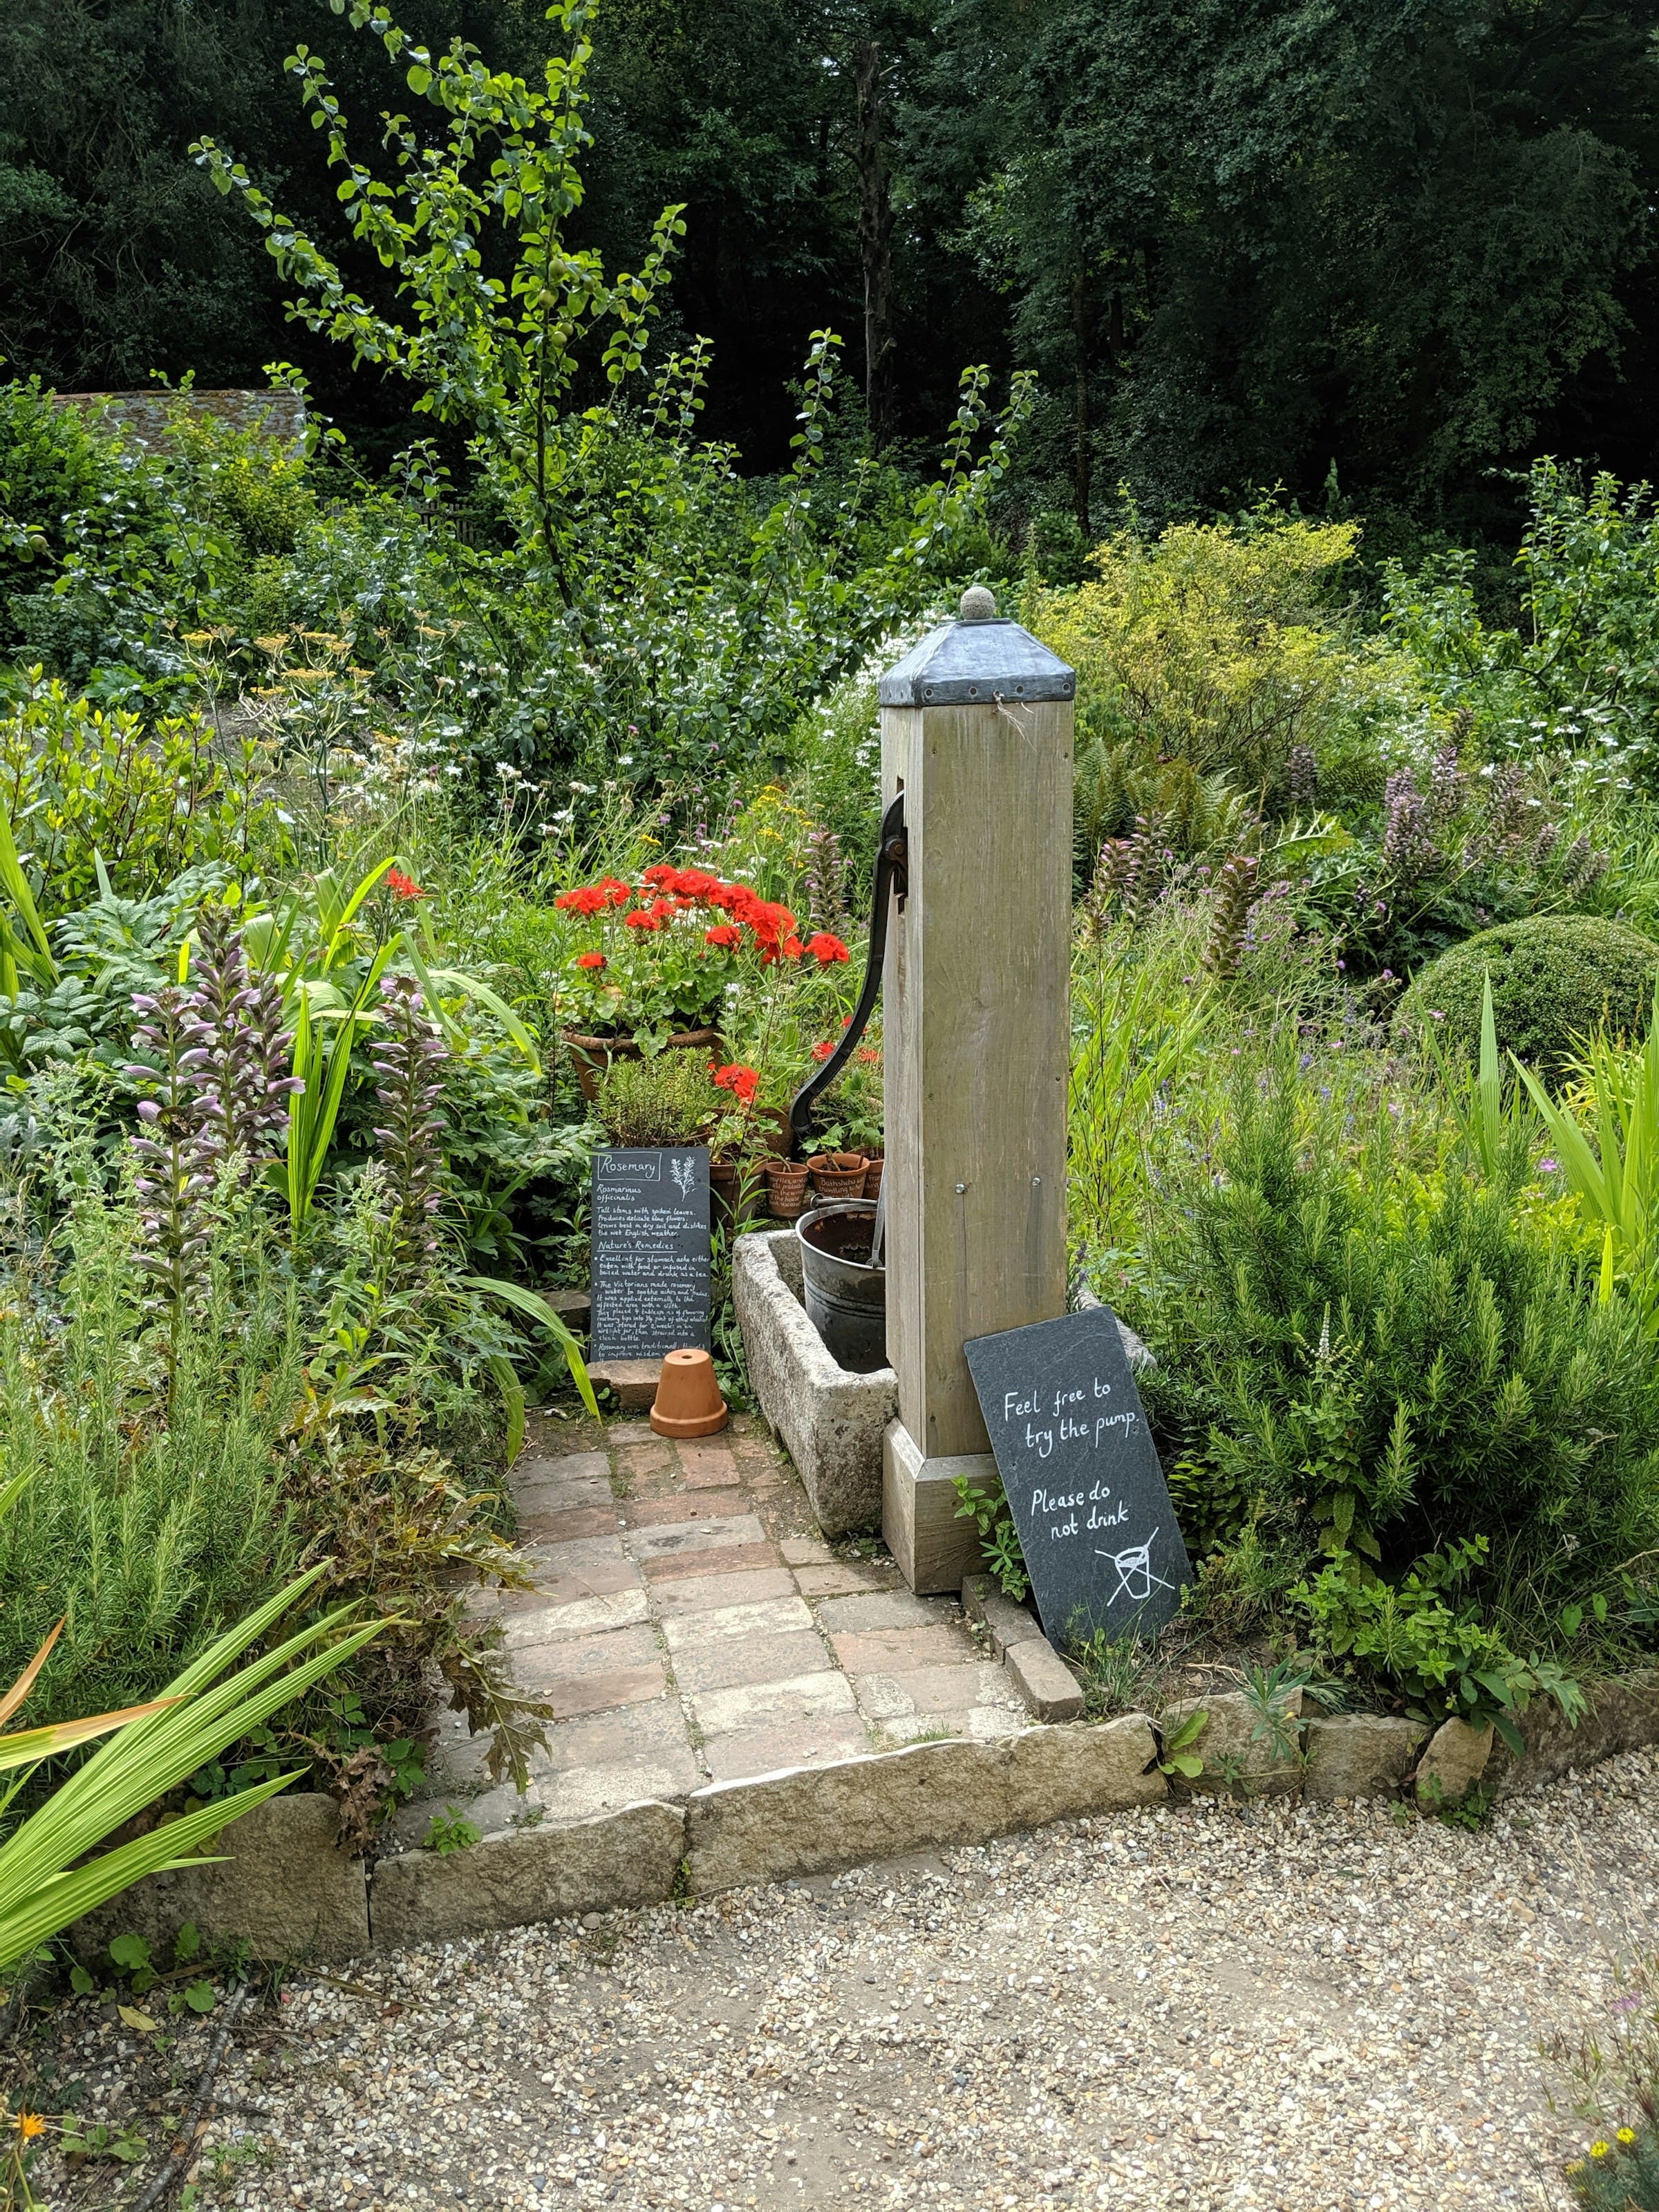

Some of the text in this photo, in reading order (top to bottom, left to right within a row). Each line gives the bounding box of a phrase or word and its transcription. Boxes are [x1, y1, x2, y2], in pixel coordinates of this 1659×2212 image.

[600, 1156, 655, 1179] Rosemary
[597, 1183, 641, 1194] Rosmarinus
[597, 1194, 635, 1203] officinalis
[612, 1205, 632, 1215] stems
[673, 1208, 696, 1216] leaves.
[597, 1221, 617, 1230] Grows
[682, 1221, 707, 1230] dislikes
[624, 1229, 650, 1239] English
[597, 1239, 674, 1250] Nature's Remedies
[599, 1254, 633, 1262] Excellent
[633, 1256, 645, 1266] for
[646, 1255, 675, 1263] stomach
[637, 1263, 651, 1272] food
[662, 1264, 688, 1273] infused
[599, 1281, 612, 1289] The
[613, 1279, 648, 1288] Victorians
[671, 1282, 696, 1292] rosemary
[627, 1287, 635, 1295] to
[619, 1295, 643, 1304] applied
[644, 1295, 674, 1305] externally
[596, 1301, 623, 1311] affected
[596, 1309, 610, 1318] They
[612, 1308, 631, 1318] placed
[597, 1315, 620, 1324] rosemary
[622, 1315, 632, 1323] tips
[667, 1316, 675, 1325] of
[598, 1342, 626, 1353] Rosemary
[635, 1349, 661, 1357] wisdom
[1004, 1376, 1111, 1422] Feel free to
[1024, 1412, 1140, 1459] try the pump.
[1031, 1479, 1111, 1517] Please do
[1051, 1499, 1130, 1540] not drink
